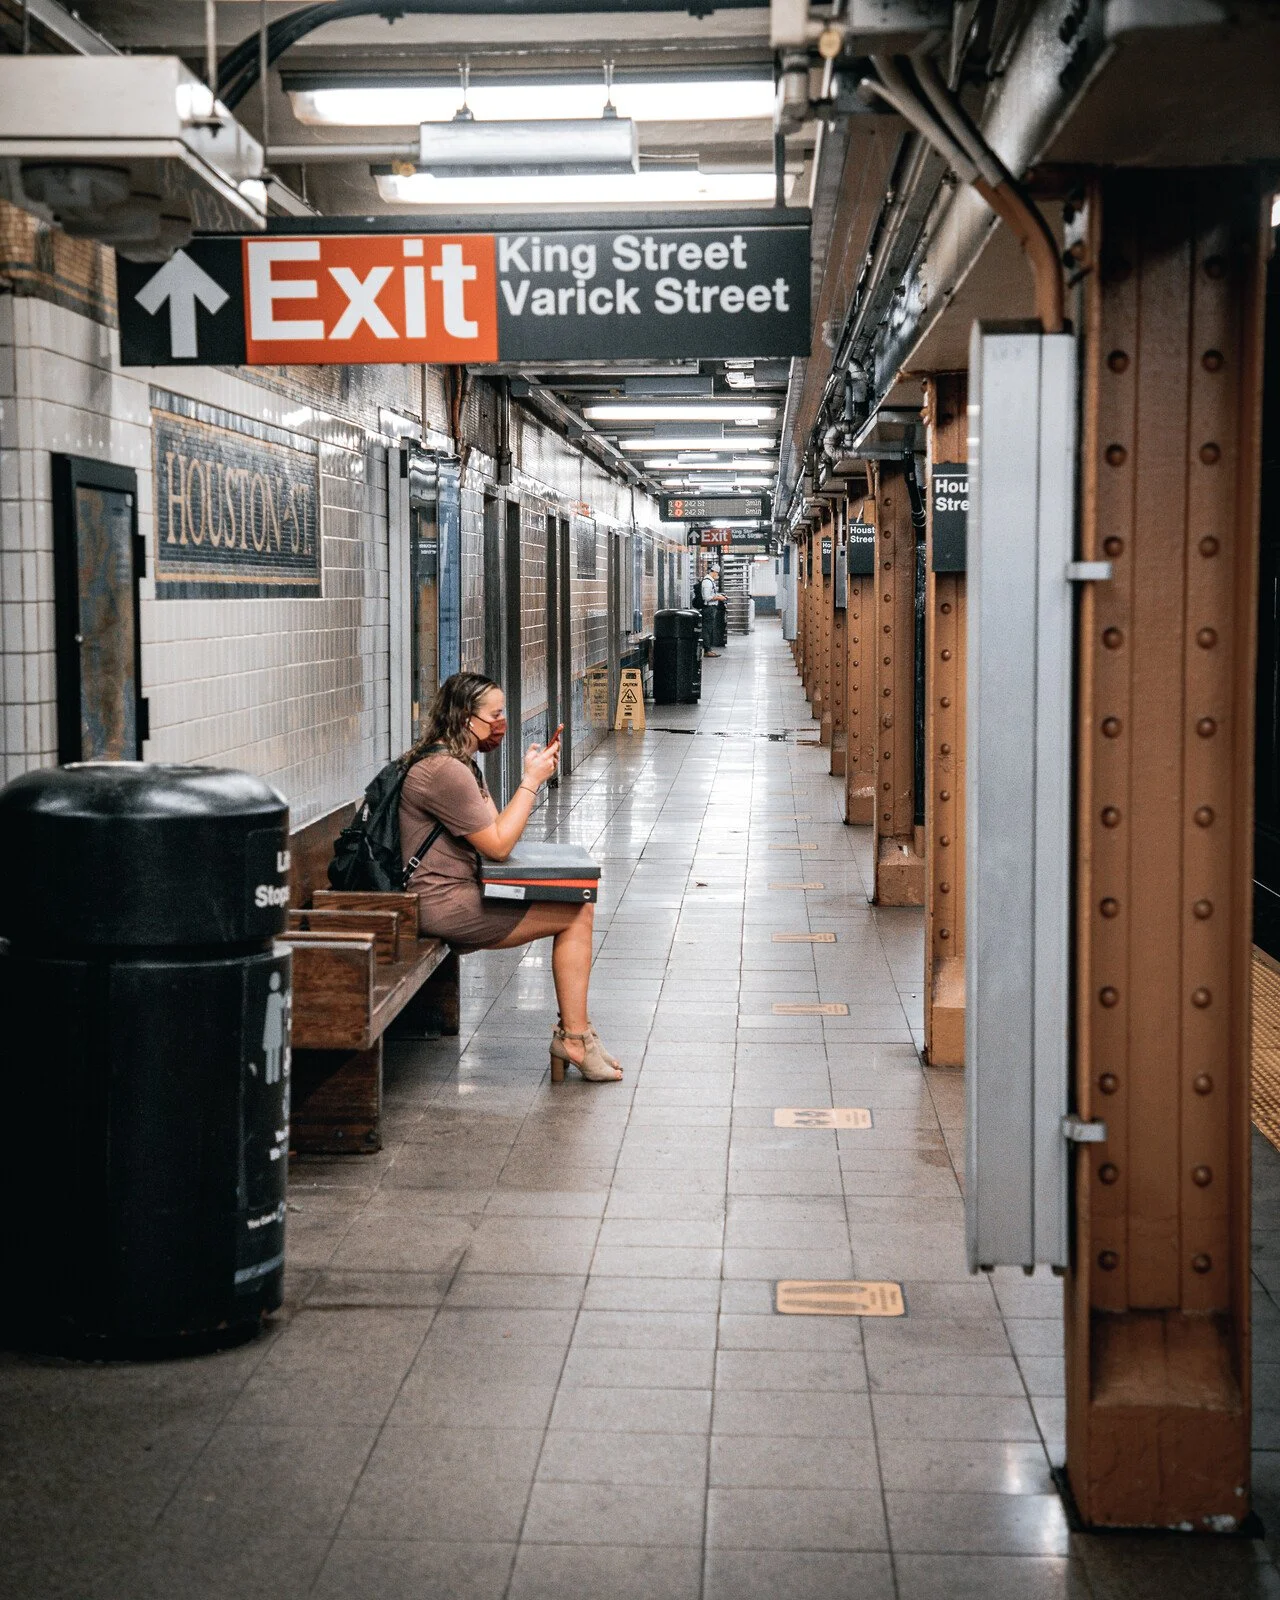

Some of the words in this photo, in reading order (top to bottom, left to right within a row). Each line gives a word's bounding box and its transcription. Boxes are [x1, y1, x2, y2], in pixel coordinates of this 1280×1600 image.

[498, 235, 597, 281] King
[612, 233, 748, 272] Street
[247, 238, 479, 342] Exit
[500, 278, 641, 317] Varick
[654, 276, 790, 315] Street
[165, 450, 283, 553] HOUSTON
[701, 529, 728, 543] Exit
